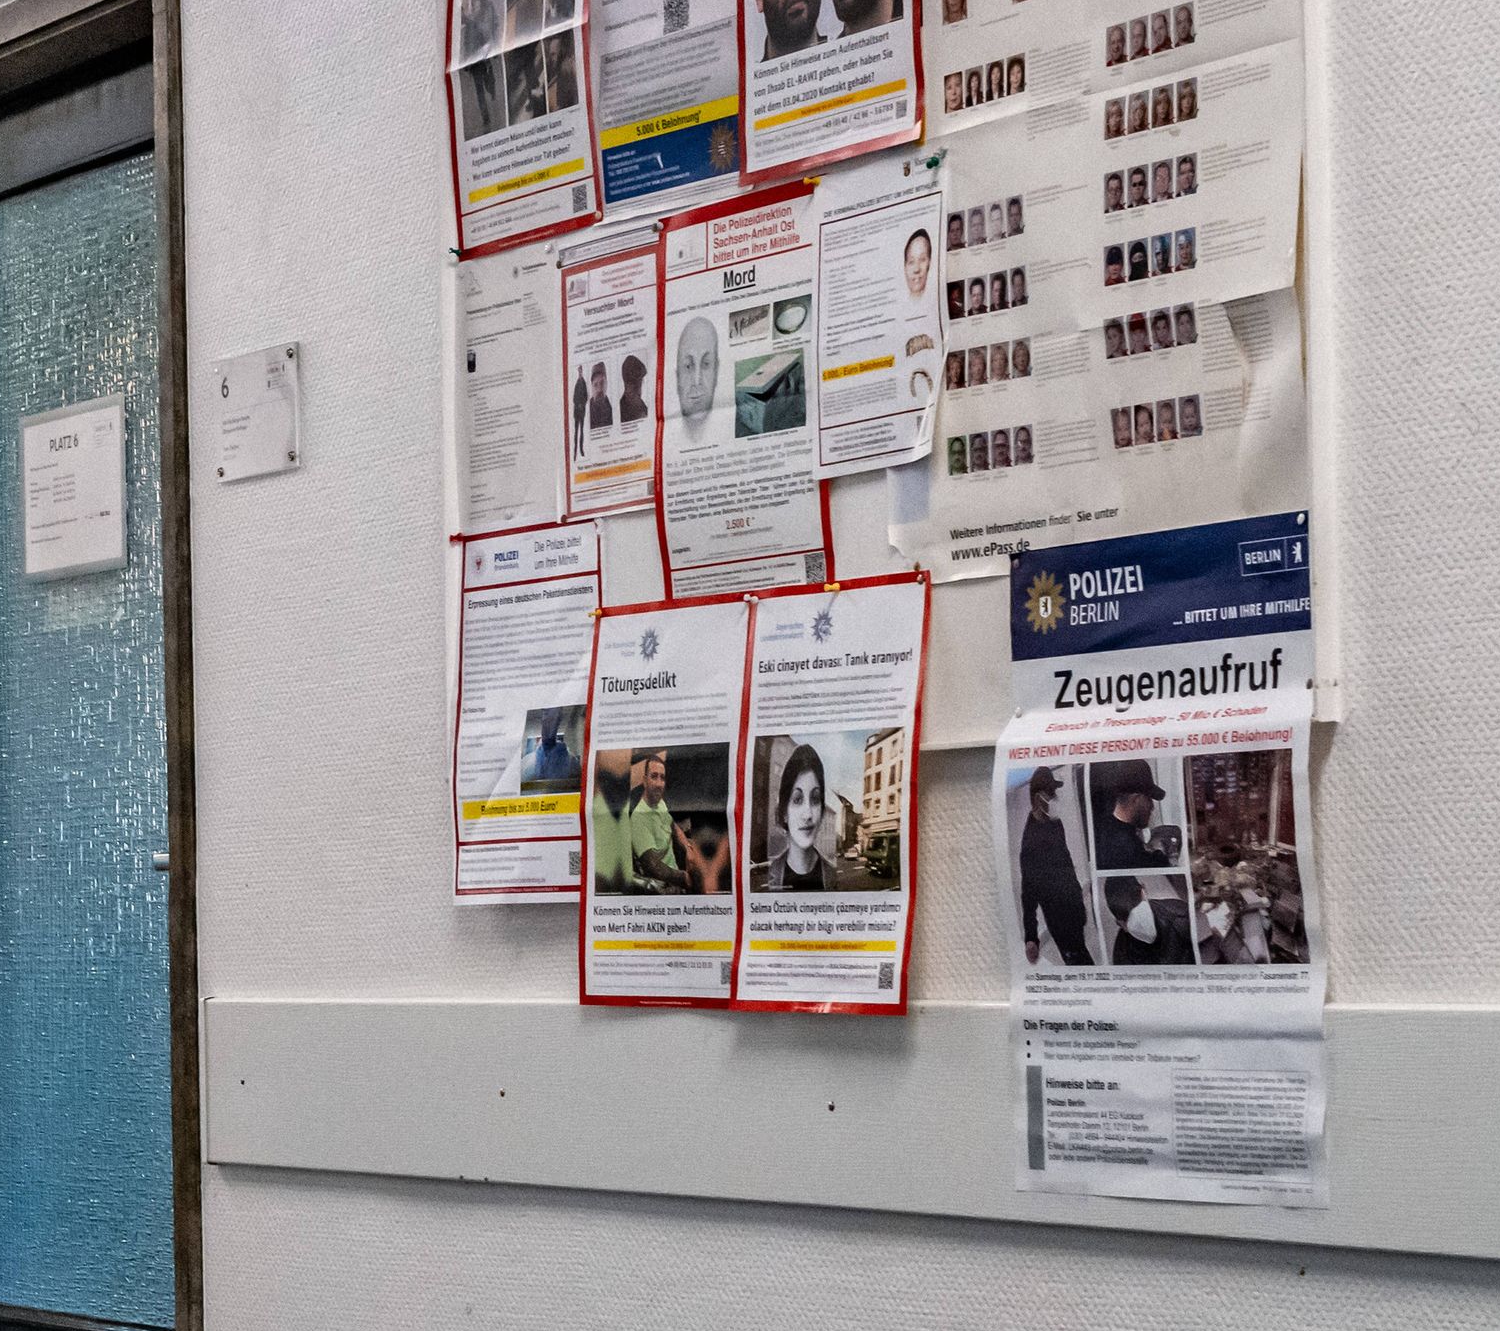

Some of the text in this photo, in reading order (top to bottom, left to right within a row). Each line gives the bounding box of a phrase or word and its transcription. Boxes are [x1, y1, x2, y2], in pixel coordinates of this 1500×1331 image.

[753, 32, 889, 80] Können Sie Hinweise zum Aufenthaltsort
[754, 89, 766, 97] von
[787, 70, 817, 88] EL-RAWI
[819, 66, 839, 81] geben,
[842, 60, 858, 71] oder
[860, 54, 880, 67] haben
[882, 49, 893, 60] Sie
[754, 105, 766, 116] seit
[768, 101, 781, 111] dem
[783, 89, 817, 107] 03.04.2020
[819, 81, 846, 98] Kontakt
[848, 72, 875, 91] gehabt?
[636, 124, 654, 136] 5.000
[656, 121, 660, 131] €
[714, 206, 792, 234] Die Polizeidirektion
[714, 220, 795, 249] Sachsen-Anhalt Ost
[713, 233, 800, 263] bittet um Ihre Mithilfe
[724, 265, 755, 289] Mord
[584, 296, 634, 317] Versuchter Mord
[222, 377, 229, 398] 6
[50, 434, 78, 452] PLATZ 6
[726, 518, 744, 529] 2.500
[949, 524, 983, 540] Weitere
[986, 517, 1046, 535] Informationen
[1077, 510, 1092, 522] Sie
[1094, 508, 1118, 520] unter
[535, 535, 582, 553] Die Polizei bittet
[951, 538, 1030, 561] www.ePass.de
[494, 551, 519, 562] POLIZEI
[535, 561, 544, 570] um
[545, 557, 557, 568] Ihre
[1244, 549, 1281, 565] BERLIN
[1069, 565, 1144, 600] POLIZEI
[1070, 601, 1119, 625] BERLIN
[1185, 598, 1309, 624] BITTET UM IHRE MITHILFE
[759, 660, 775, 673] Eski
[777, 658, 809, 674] cinayet
[845, 651, 868, 666] Tanık
[871, 648, 912, 666] aranıyor!
[601, 672, 677, 695] Tötungsdelikt
[1054, 648, 1282, 713] Zeugenaufruf
[1009, 726, 1293, 760] WER KENNT DIESE PERSON? Bis zu 55.000 € Belohnung!
[593, 905, 620, 916] Können
[623, 905, 633, 915] Sie
[635, 905, 665, 915] Hinweise
[683, 905, 732, 915] Aufenthaltsort
[750, 902, 771, 913] Selma
[773, 900, 797, 913] Öztürk
[609, 923, 625, 932] Mert
[646, 923, 665, 932] AKIN
[667, 923, 690, 935] geben?
[750, 921, 772, 932] olacak
[774, 921, 805, 934] herhangi
[806, 921, 816, 932] bir
[818, 920, 834, 934] bilgi
[1024, 1020, 1119, 1032] Die Fragen der Polizei:
[1046, 1078, 1121, 1090] Hinweise bitte an:
